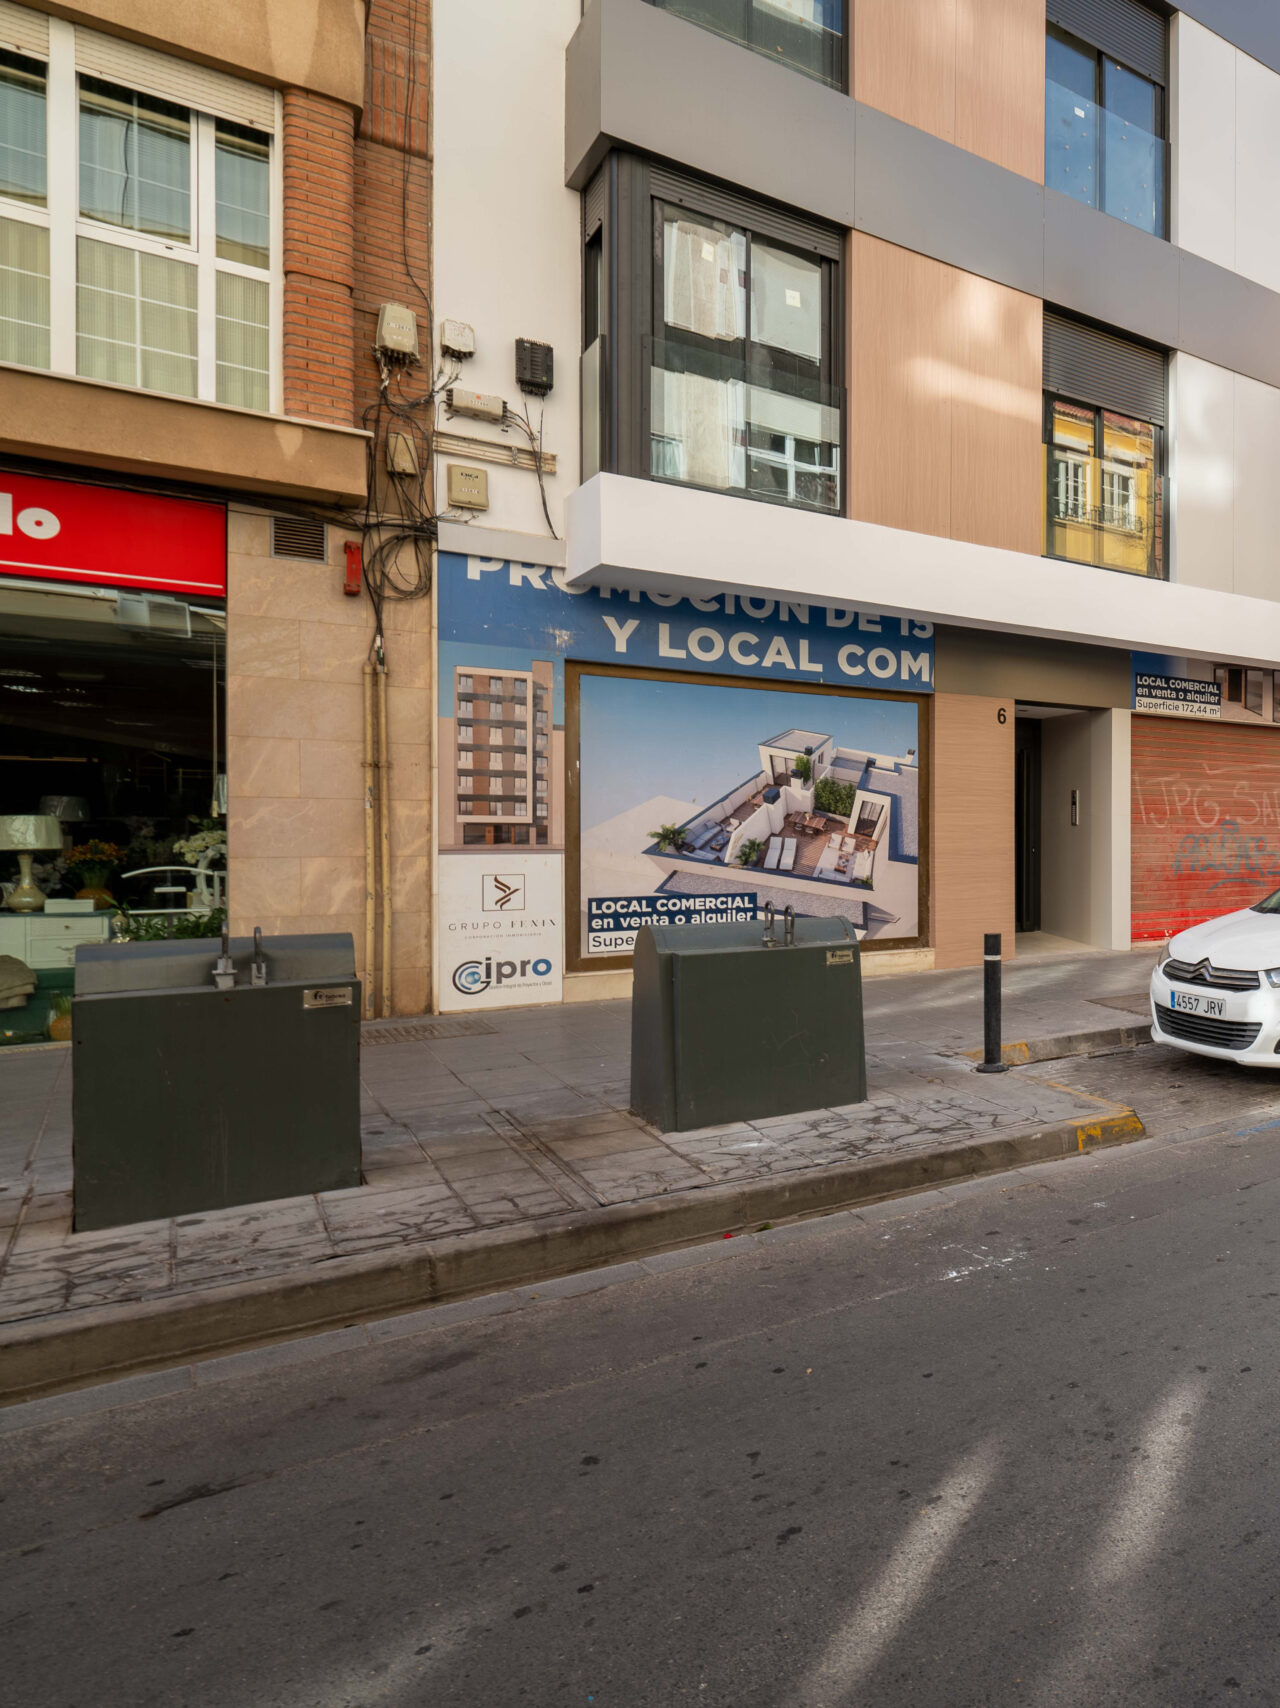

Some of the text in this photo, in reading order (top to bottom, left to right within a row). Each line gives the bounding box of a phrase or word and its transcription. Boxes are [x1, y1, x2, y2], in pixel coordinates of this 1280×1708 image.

[826, 607, 882, 632] DE
[602, 615, 640, 653] Y
[658, 622, 823, 673] LOCAL
[1137, 675, 1219, 693] LOCAL COMERCIAL
[1137, 687, 1148, 696] en
[1151, 688, 1176, 699] venta
[1186, 691, 1219, 704] alquiler
[997, 707, 1007, 724] 6
[1137, 699, 1179, 712] Superficie
[1181, 703, 1207, 715] 172,44
[591, 896, 753, 914] LOCAL COMERCIAL
[448, 921, 502, 931] GRUPO
[591, 917, 614, 929] en
[619, 913, 669, 928] venta
[674, 915, 685, 925] o
[1177, 994, 1223, 1016] 4557 JRV
